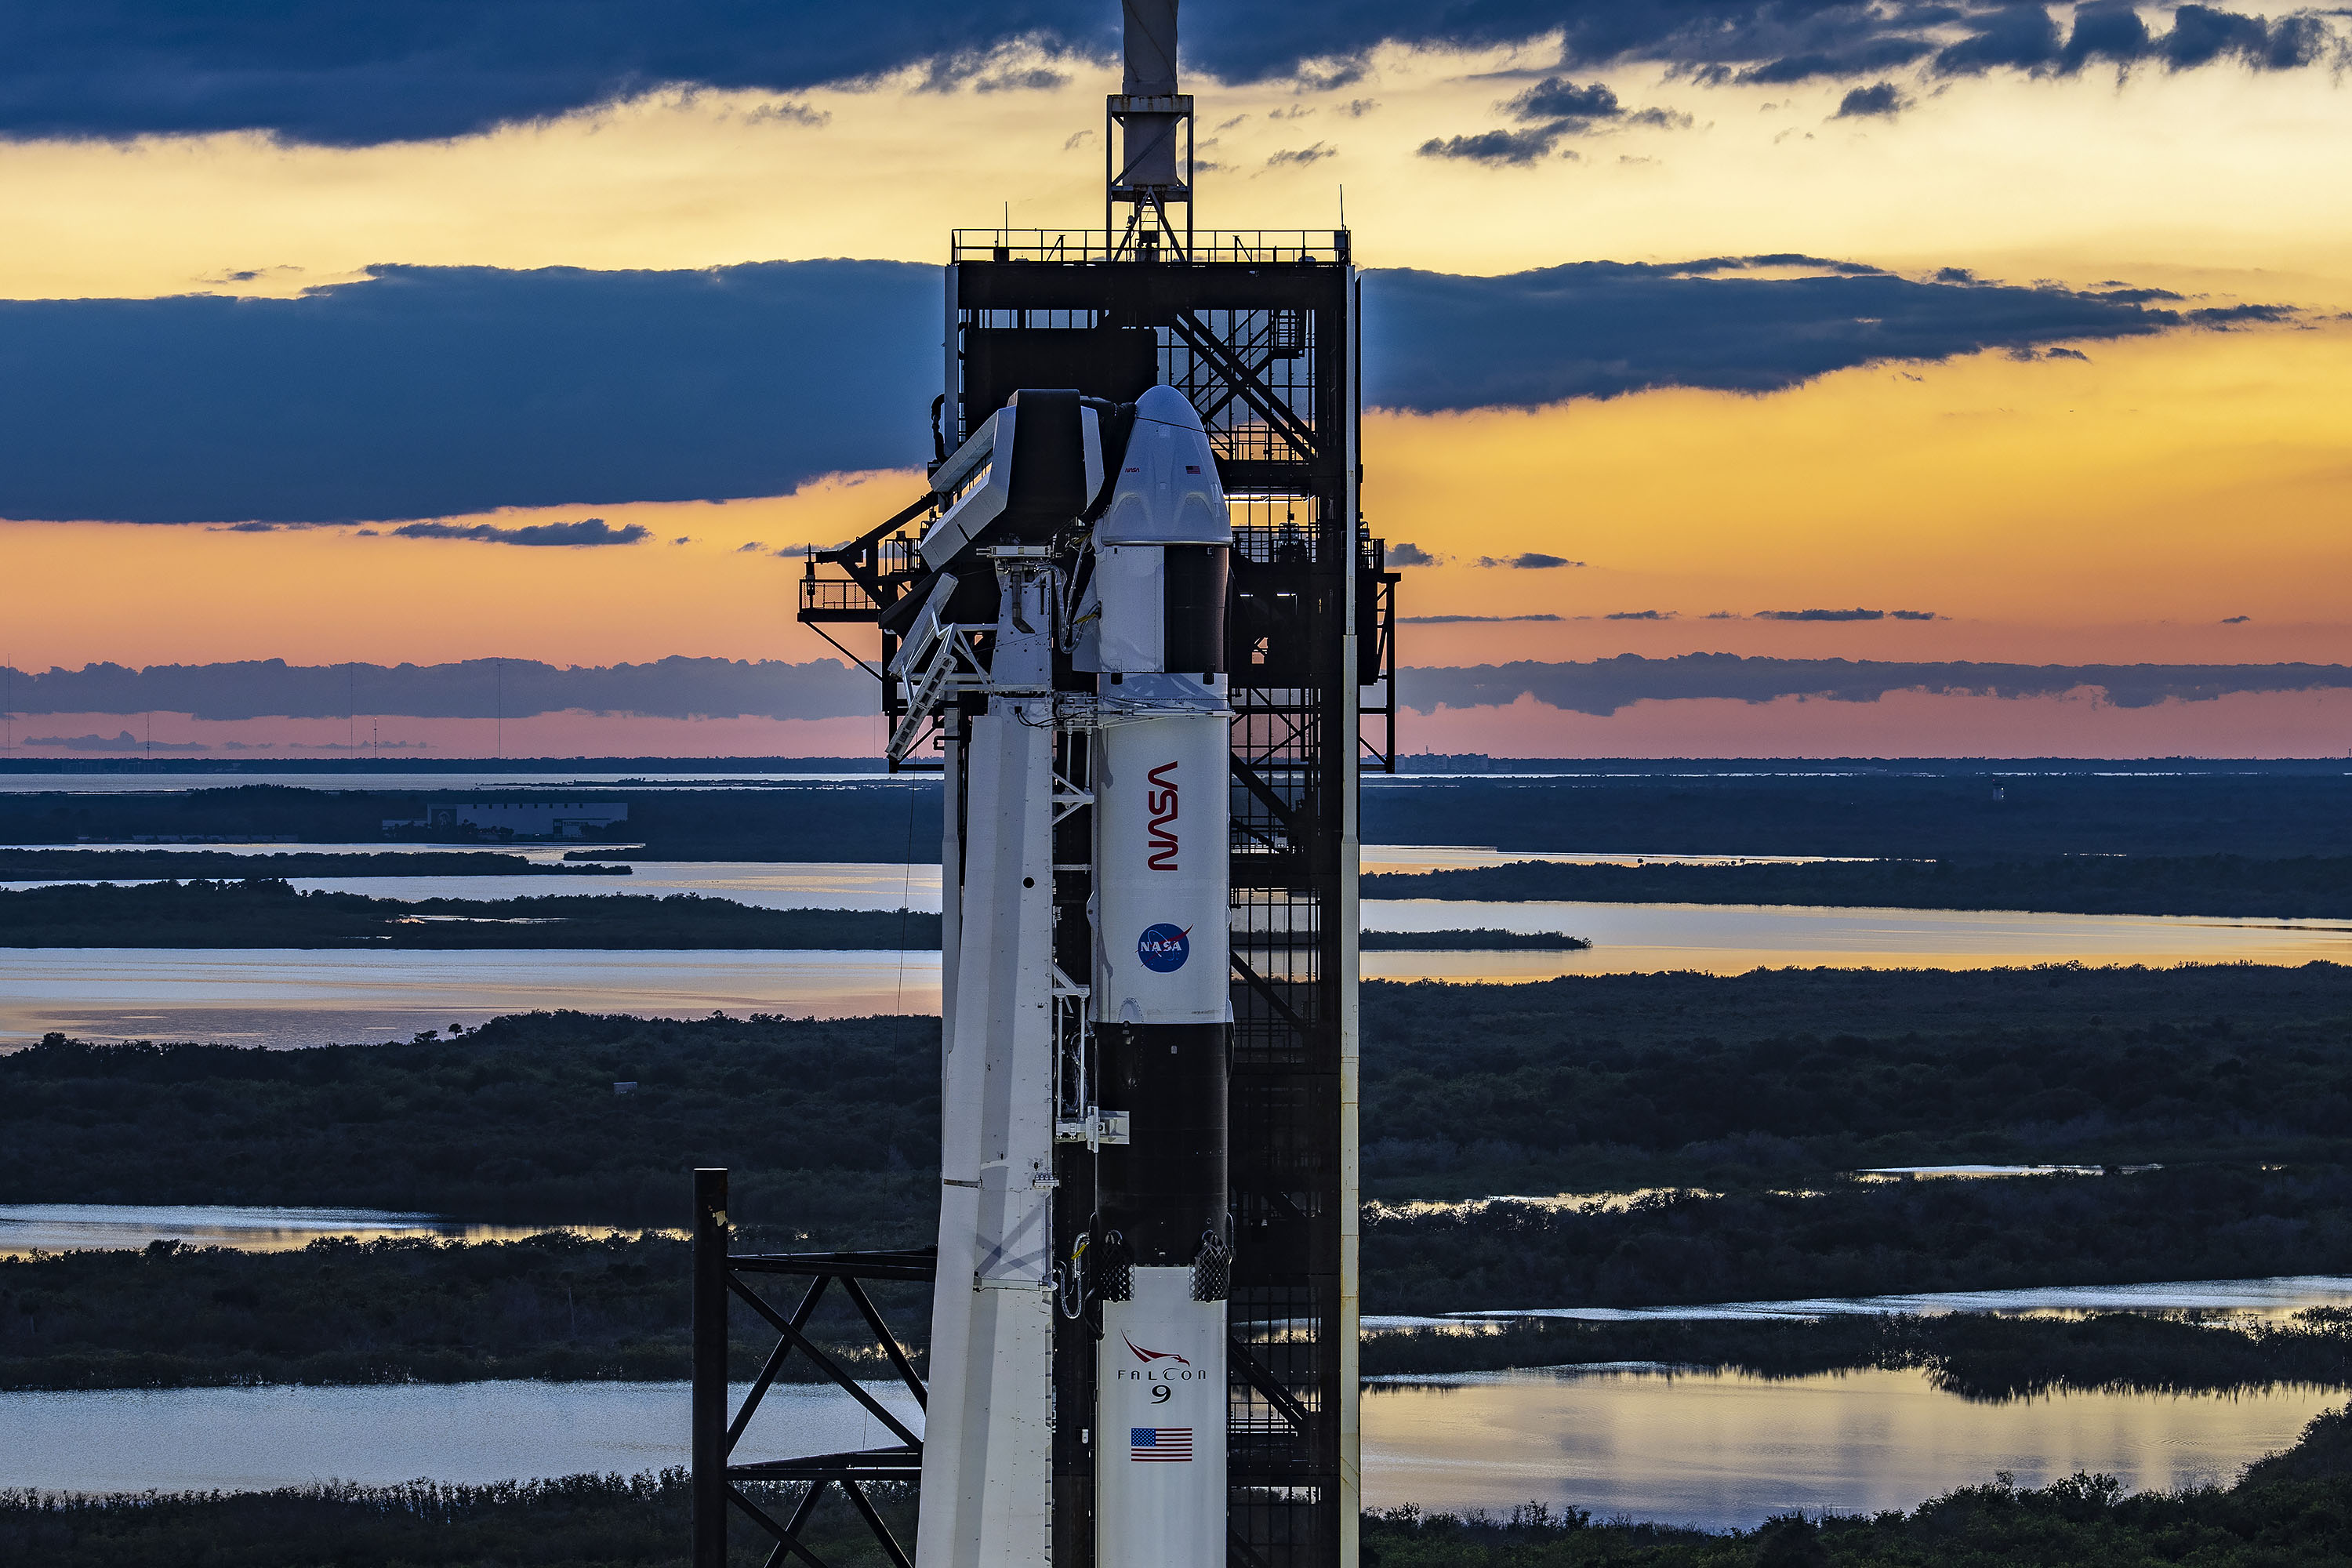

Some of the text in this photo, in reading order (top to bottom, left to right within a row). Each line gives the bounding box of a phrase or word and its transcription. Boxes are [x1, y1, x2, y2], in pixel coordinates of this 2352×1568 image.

[1147, 760, 1179, 871] NASA
[1141, 941, 1181, 952] NASA
[1117, 1368, 1206, 1381] FALCON
[1150, 1385, 1171, 1404] 9
